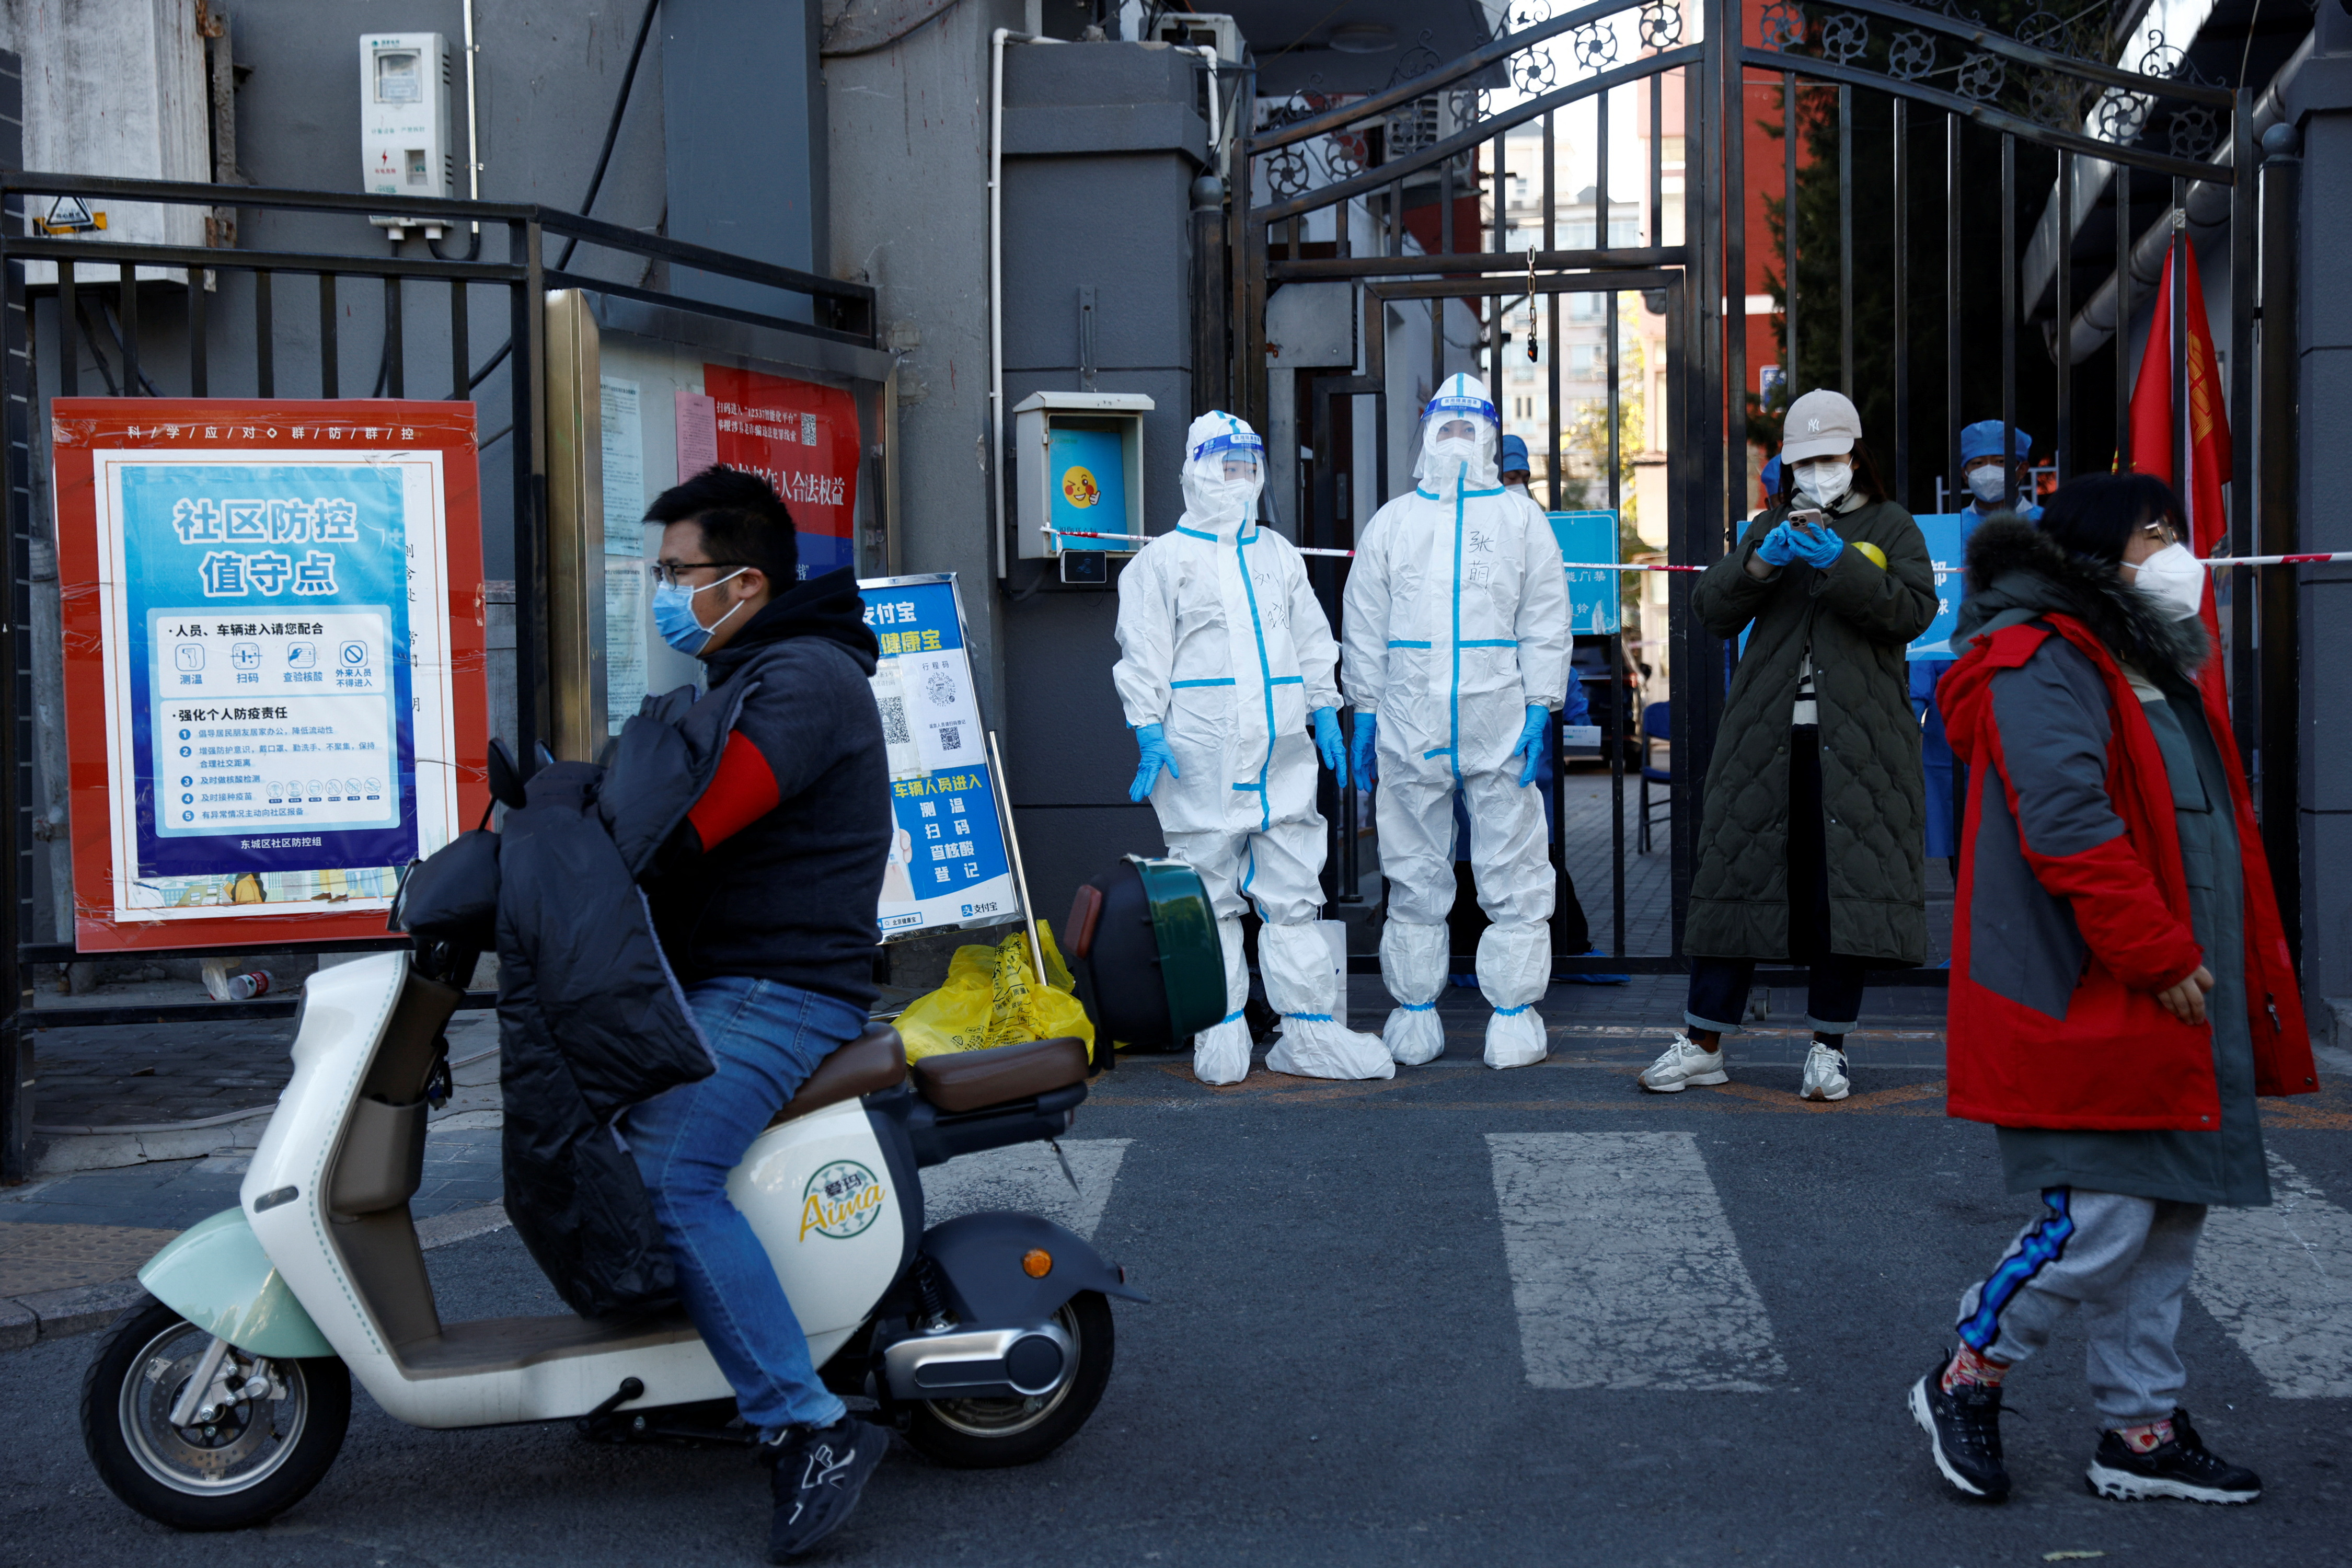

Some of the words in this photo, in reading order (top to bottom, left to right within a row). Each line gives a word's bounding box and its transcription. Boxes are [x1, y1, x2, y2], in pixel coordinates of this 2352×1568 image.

[1808, 418, 1820, 432] NY
[173, 498, 358, 544] 社区防控
[198, 550, 339, 597] 值守点
[862, 601, 917, 626] 支付宝
[876, 629, 942, 655] 健康宝
[922, 660, 949, 671] 行程码
[236, 673, 259, 683] 扫码
[283, 672, 323, 682] 查验核酸
[336, 668, 372, 677] 外来人员
[180, 674, 203, 685] 测温
[336, 678, 372, 687] 不得进入
[200, 758, 251, 768] 合理社交距离
[200, 775, 260, 785] 及时做核酸检测
[893, 774, 982, 798] 车辆人员进入
[201, 792, 252, 802] 及时接种疫苗
[202, 808, 304, 820] 有异常情况主动向社区报备
[240, 837, 322, 850] 东城区社区防控组
[930, 840, 975, 861] 查核酸
[973, 902, 998, 914] 支付宝
[892, 917, 917, 926] 北京健康宝
[824, 1173, 862, 1199] 爱玛
[799, 1184, 886, 1243] Aima
